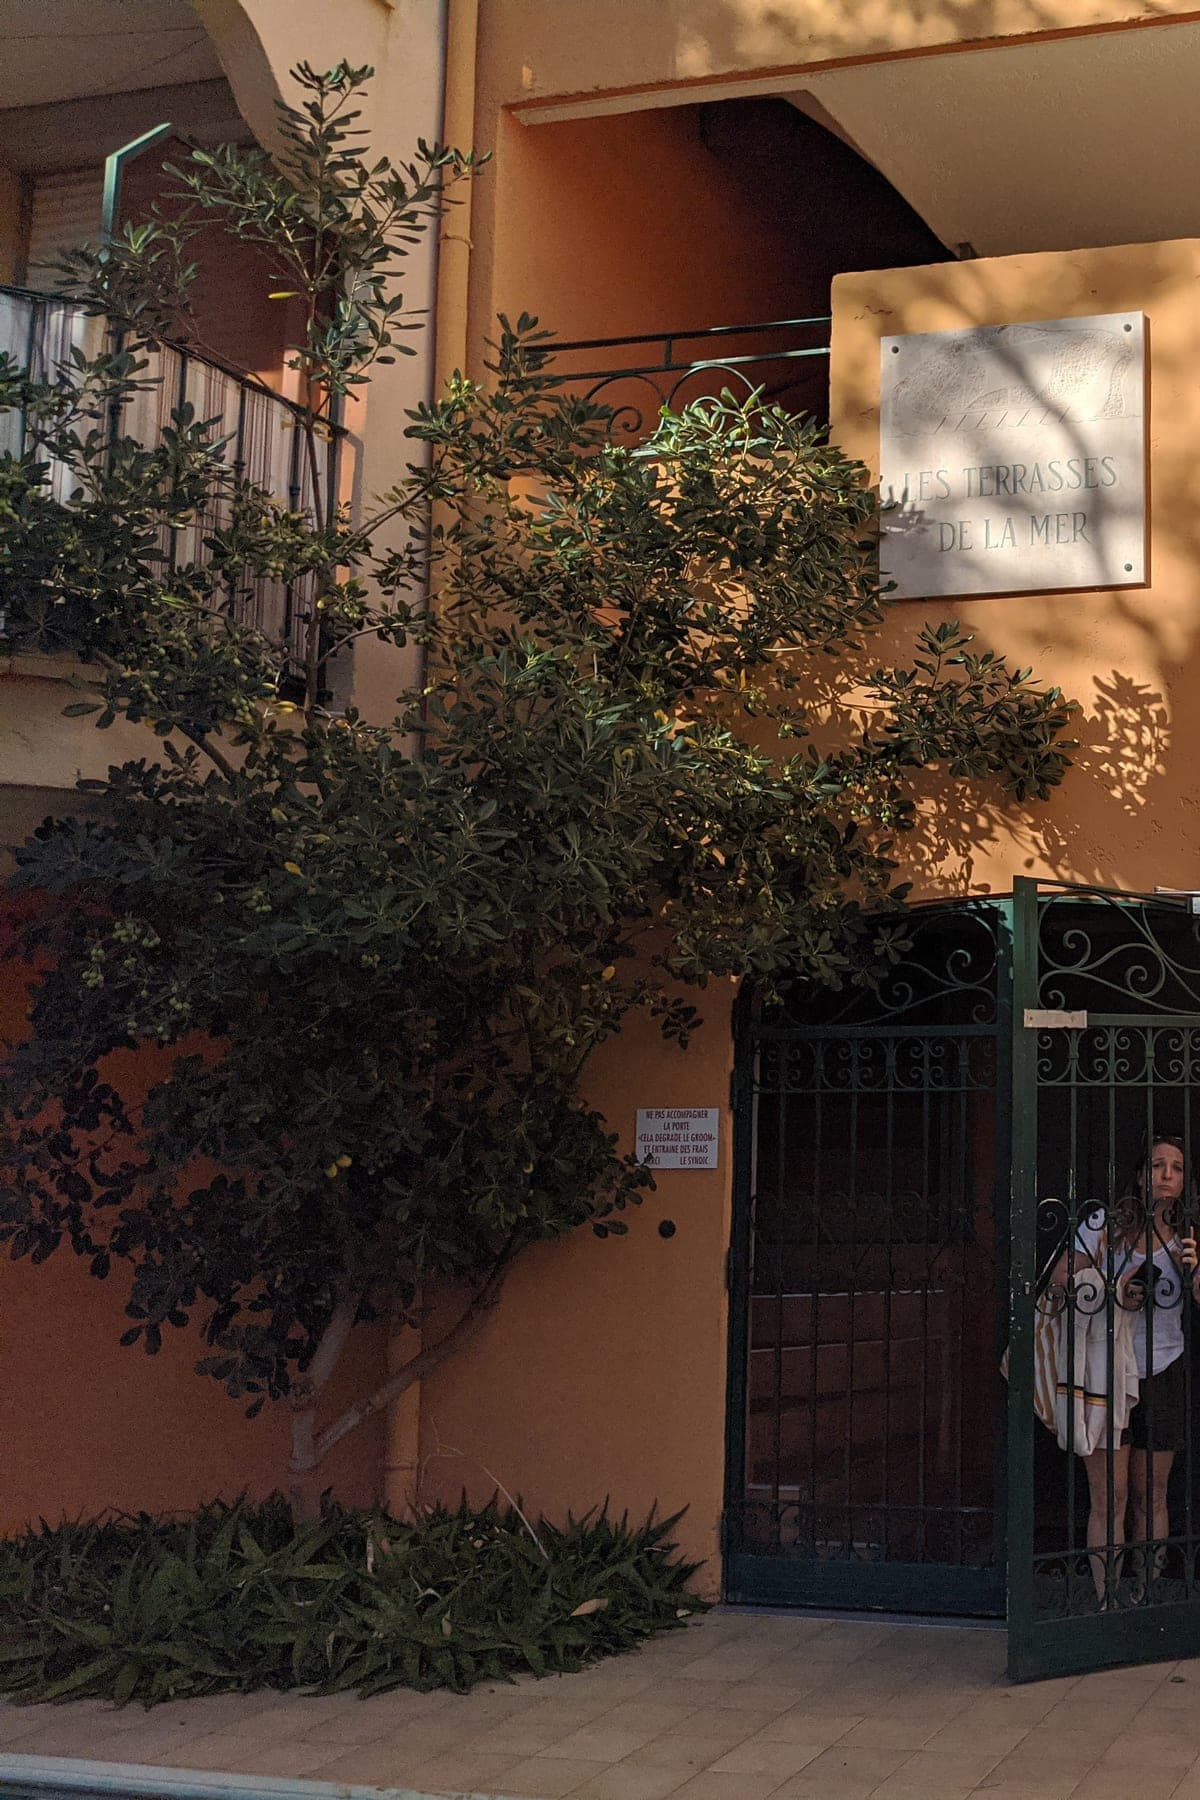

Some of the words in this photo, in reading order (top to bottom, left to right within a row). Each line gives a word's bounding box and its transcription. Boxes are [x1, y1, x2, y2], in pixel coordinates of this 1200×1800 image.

[903, 469, 951, 502] LES
[963, 456, 1117, 498] TERRASSES
[938, 520, 972, 552] DE
[984, 517, 1018, 549] LA
[1030, 511, 1091, 545] MER
[646, 1110, 653, 1119] NE
[655, 1110, 665, 1119] PAS
[666, 1110, 708, 1119] ACCOMPAGNER
[663, 1122, 671, 1131] LA
[672, 1122, 690, 1130] PORTE
[683, 1133, 689, 1142] LE
[644, 1145, 651, 1154] ET
[680, 1145, 691, 1153] DES
[692, 1145, 708, 1153] FRAIS
[680, 1157, 688, 1165] LE
[689, 1157, 709, 1165] SYNDIC
